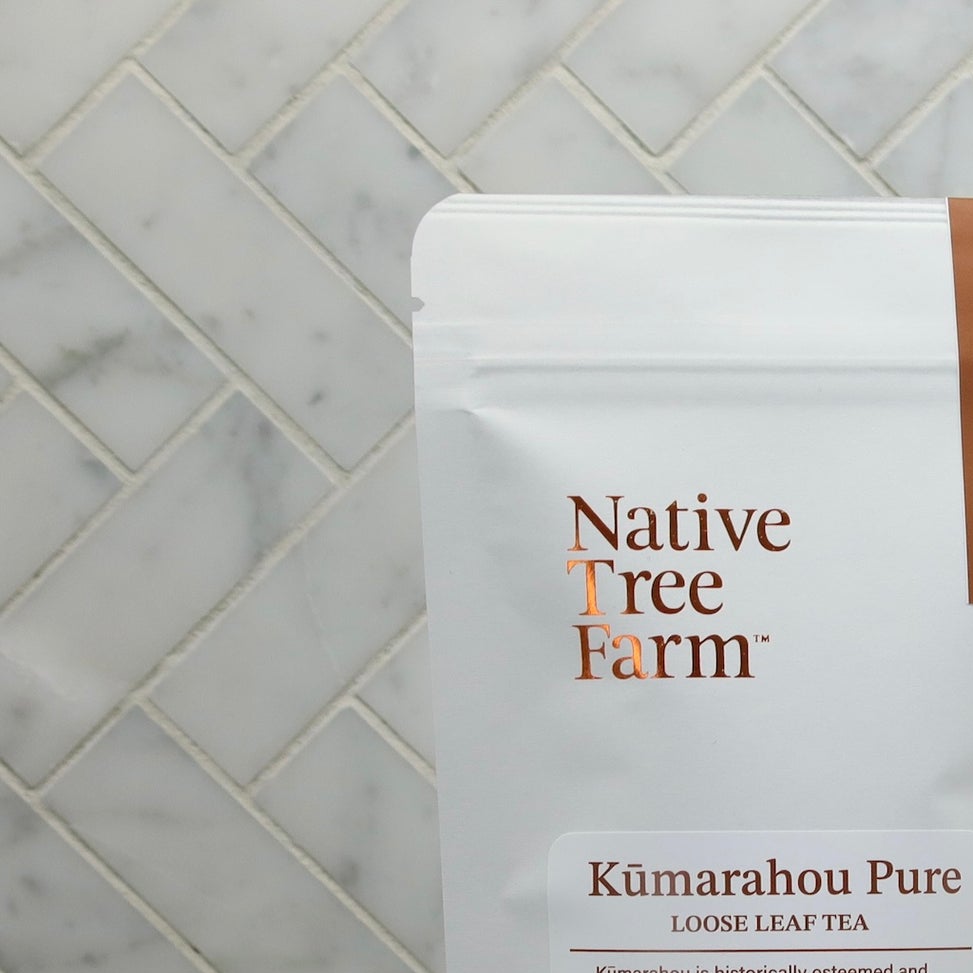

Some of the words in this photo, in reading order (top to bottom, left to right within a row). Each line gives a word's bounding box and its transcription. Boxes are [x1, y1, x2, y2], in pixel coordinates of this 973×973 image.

[567, 493, 791, 552] Native
[567, 559, 724, 616] Tree
[588, 858, 852, 897] Kūmarahou
[866, 859, 962, 895] Pure
[671, 914, 749, 933] LOOSE
[754, 914, 817, 932] LEAF
[821, 913, 870, 931] TEA
